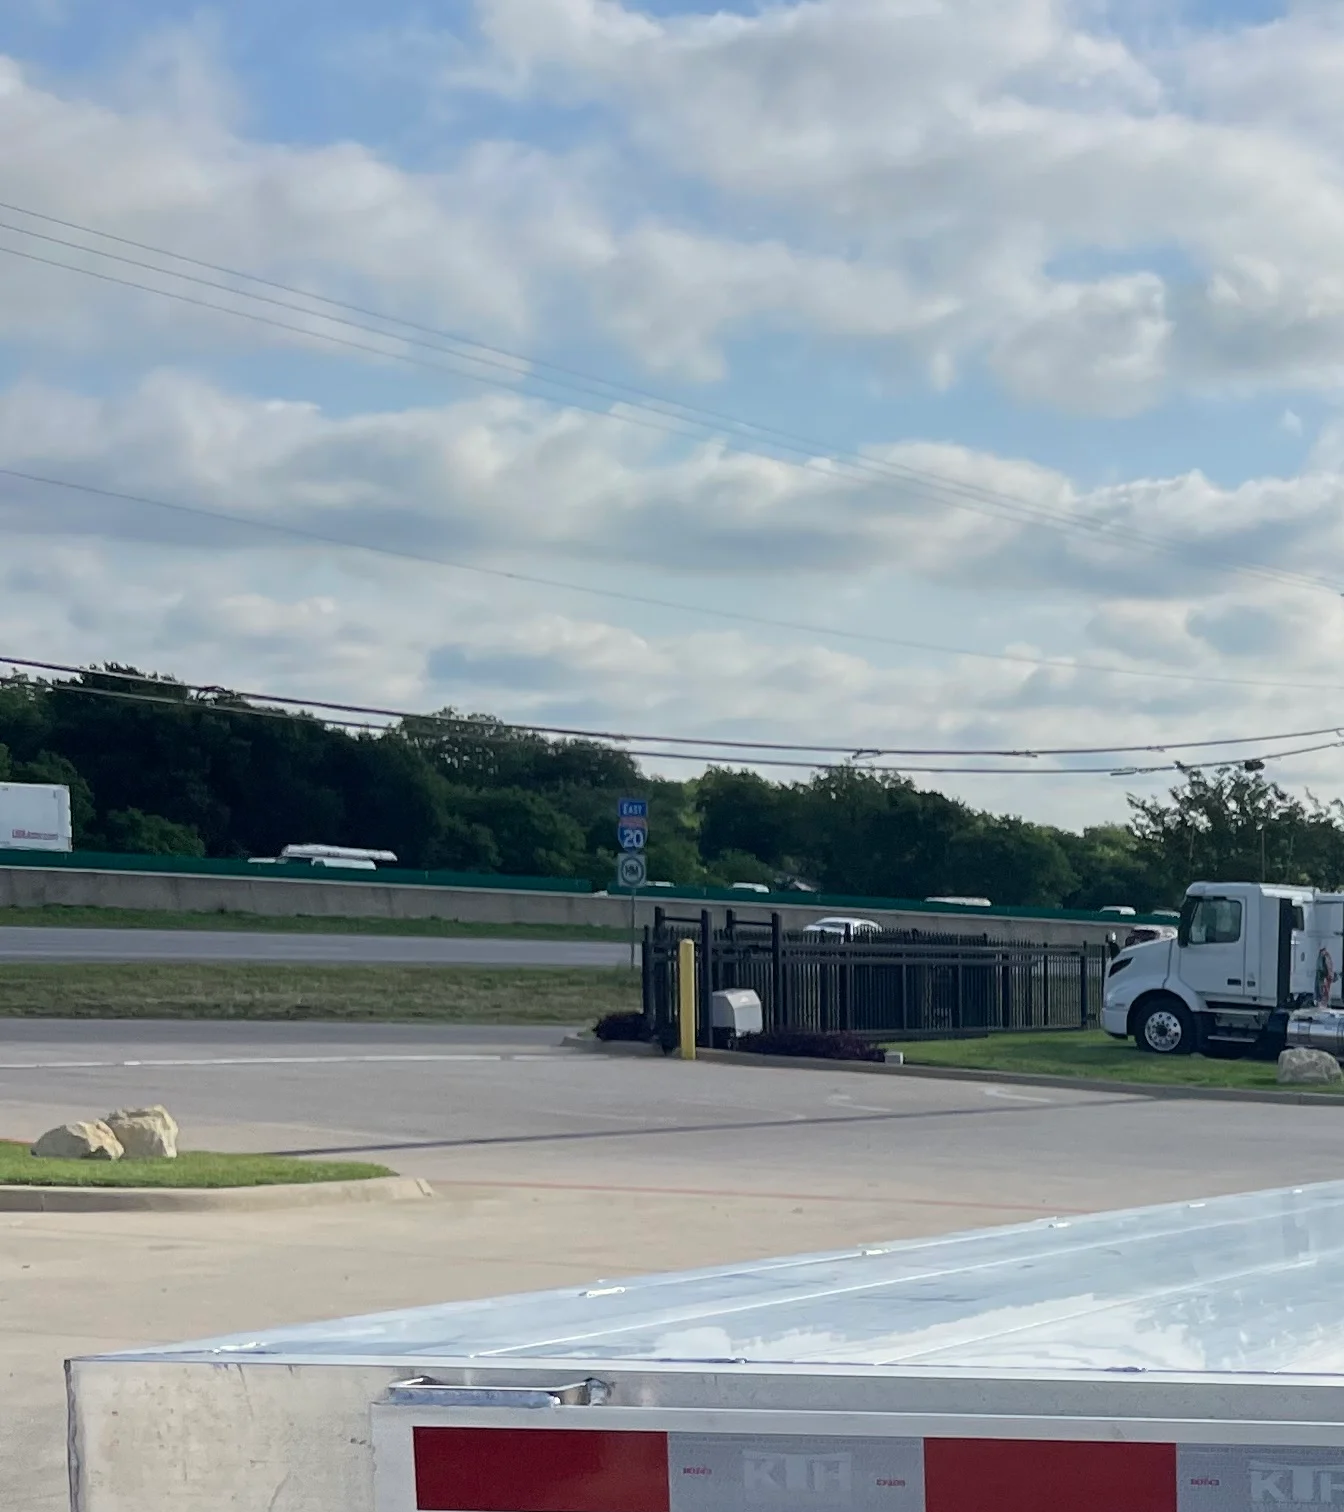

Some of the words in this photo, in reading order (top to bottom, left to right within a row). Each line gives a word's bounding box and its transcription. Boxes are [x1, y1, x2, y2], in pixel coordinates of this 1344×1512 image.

[623, 802, 643, 815] EAST
[623, 828, 644, 849] 20
[742, 1450, 851, 1491] KTH
